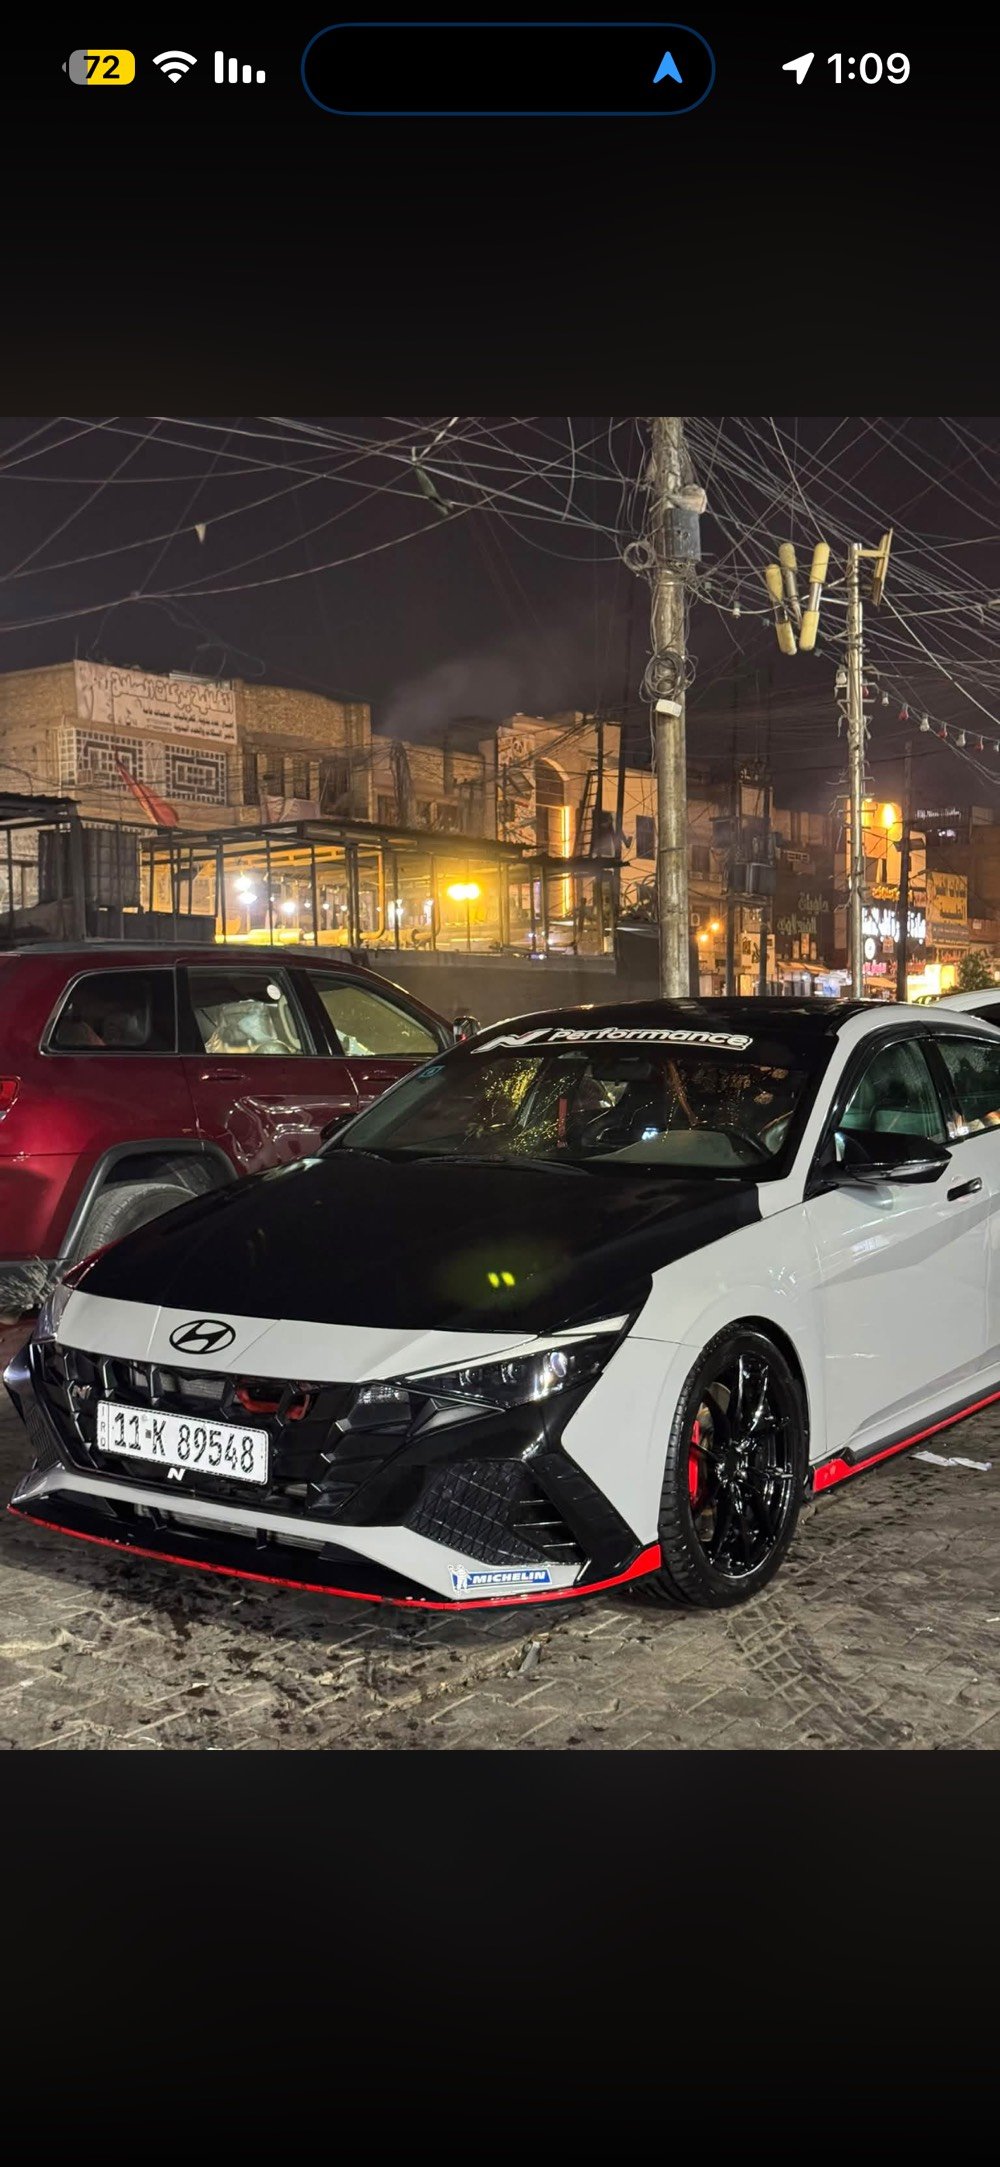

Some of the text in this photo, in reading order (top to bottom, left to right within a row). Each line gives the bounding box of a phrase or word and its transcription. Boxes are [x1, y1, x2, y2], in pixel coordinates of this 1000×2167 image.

[547, 1027, 752, 1050] Performance
[176, 1424, 255, 1474] 89548
[167, 1467, 186, 1481] N
[472, 1571, 546, 1584] MICHELIN
